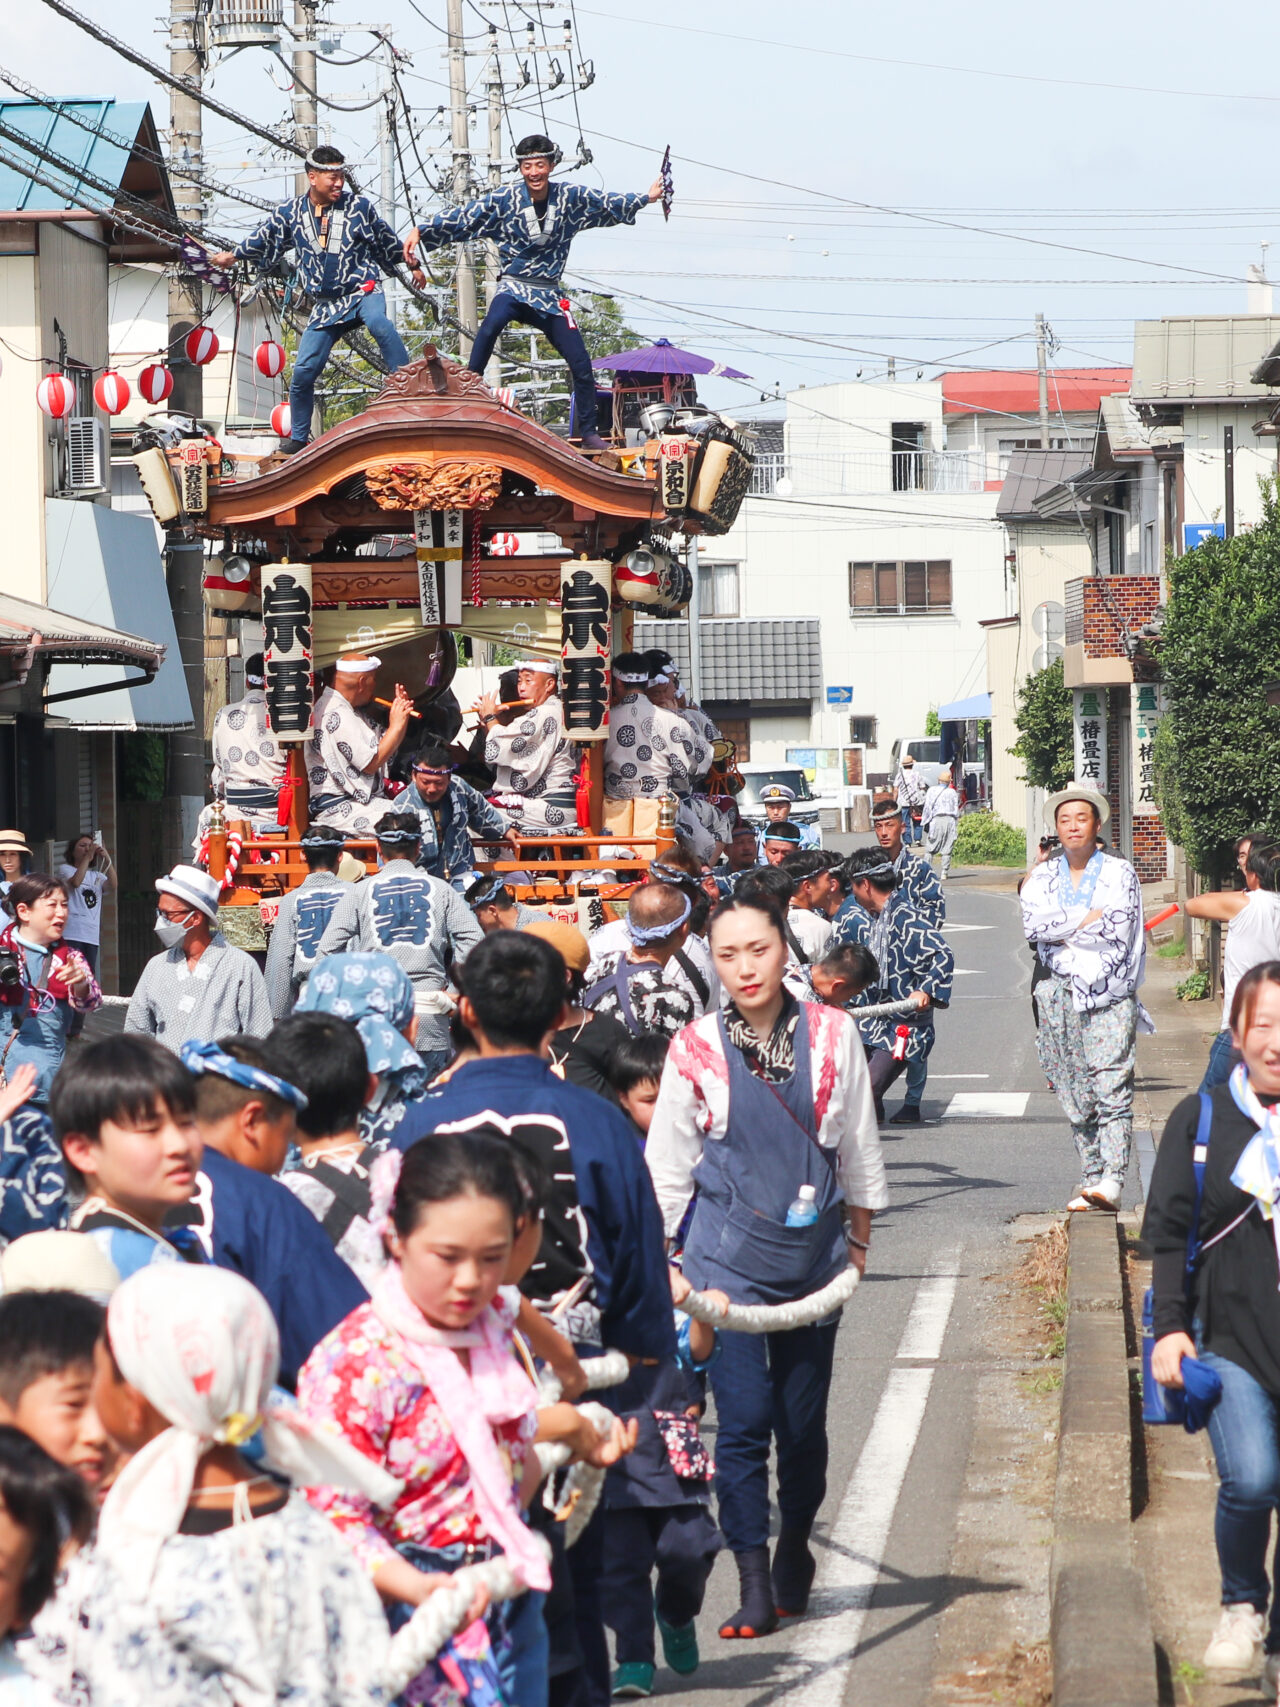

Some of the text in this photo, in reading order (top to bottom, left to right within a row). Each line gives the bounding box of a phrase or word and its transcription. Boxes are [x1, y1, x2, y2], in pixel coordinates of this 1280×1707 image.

[264, 574, 313, 733] 宗吾
[561, 570, 609, 731] 宗吾
[1080, 693, 1101, 716] 畳
[1136, 686, 1157, 711] 畳
[1080, 720, 1102, 779] 椿畳店
